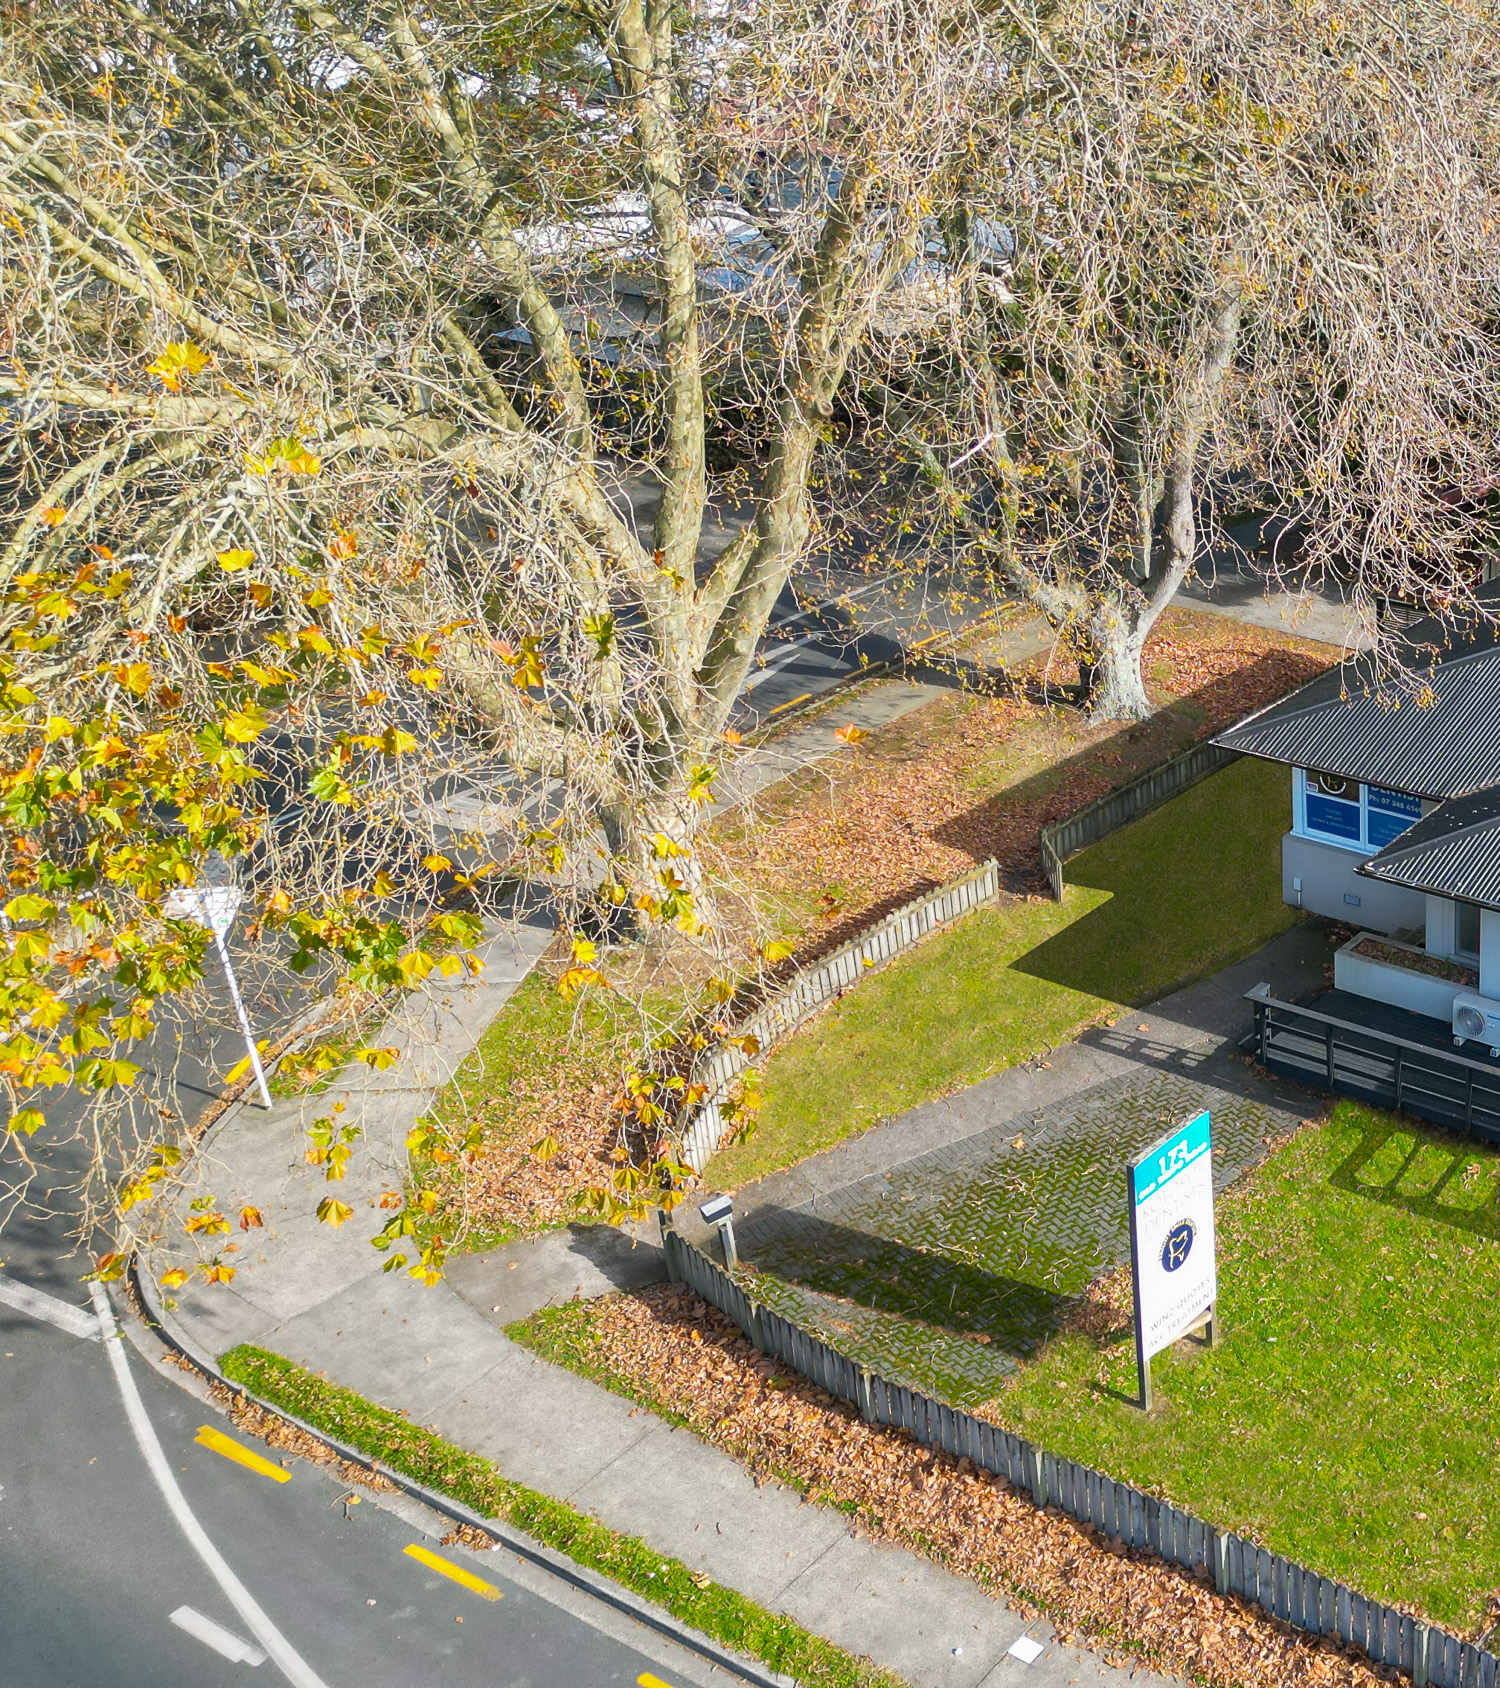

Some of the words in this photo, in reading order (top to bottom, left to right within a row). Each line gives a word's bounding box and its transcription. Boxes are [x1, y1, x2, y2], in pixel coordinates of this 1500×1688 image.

[1381, 797, 1390, 805] 07
[1392, 800, 1405, 809] 348
[1177, 1278, 1209, 1309] QUOTES
[1168, 1288, 1212, 1332] TREATMENT
